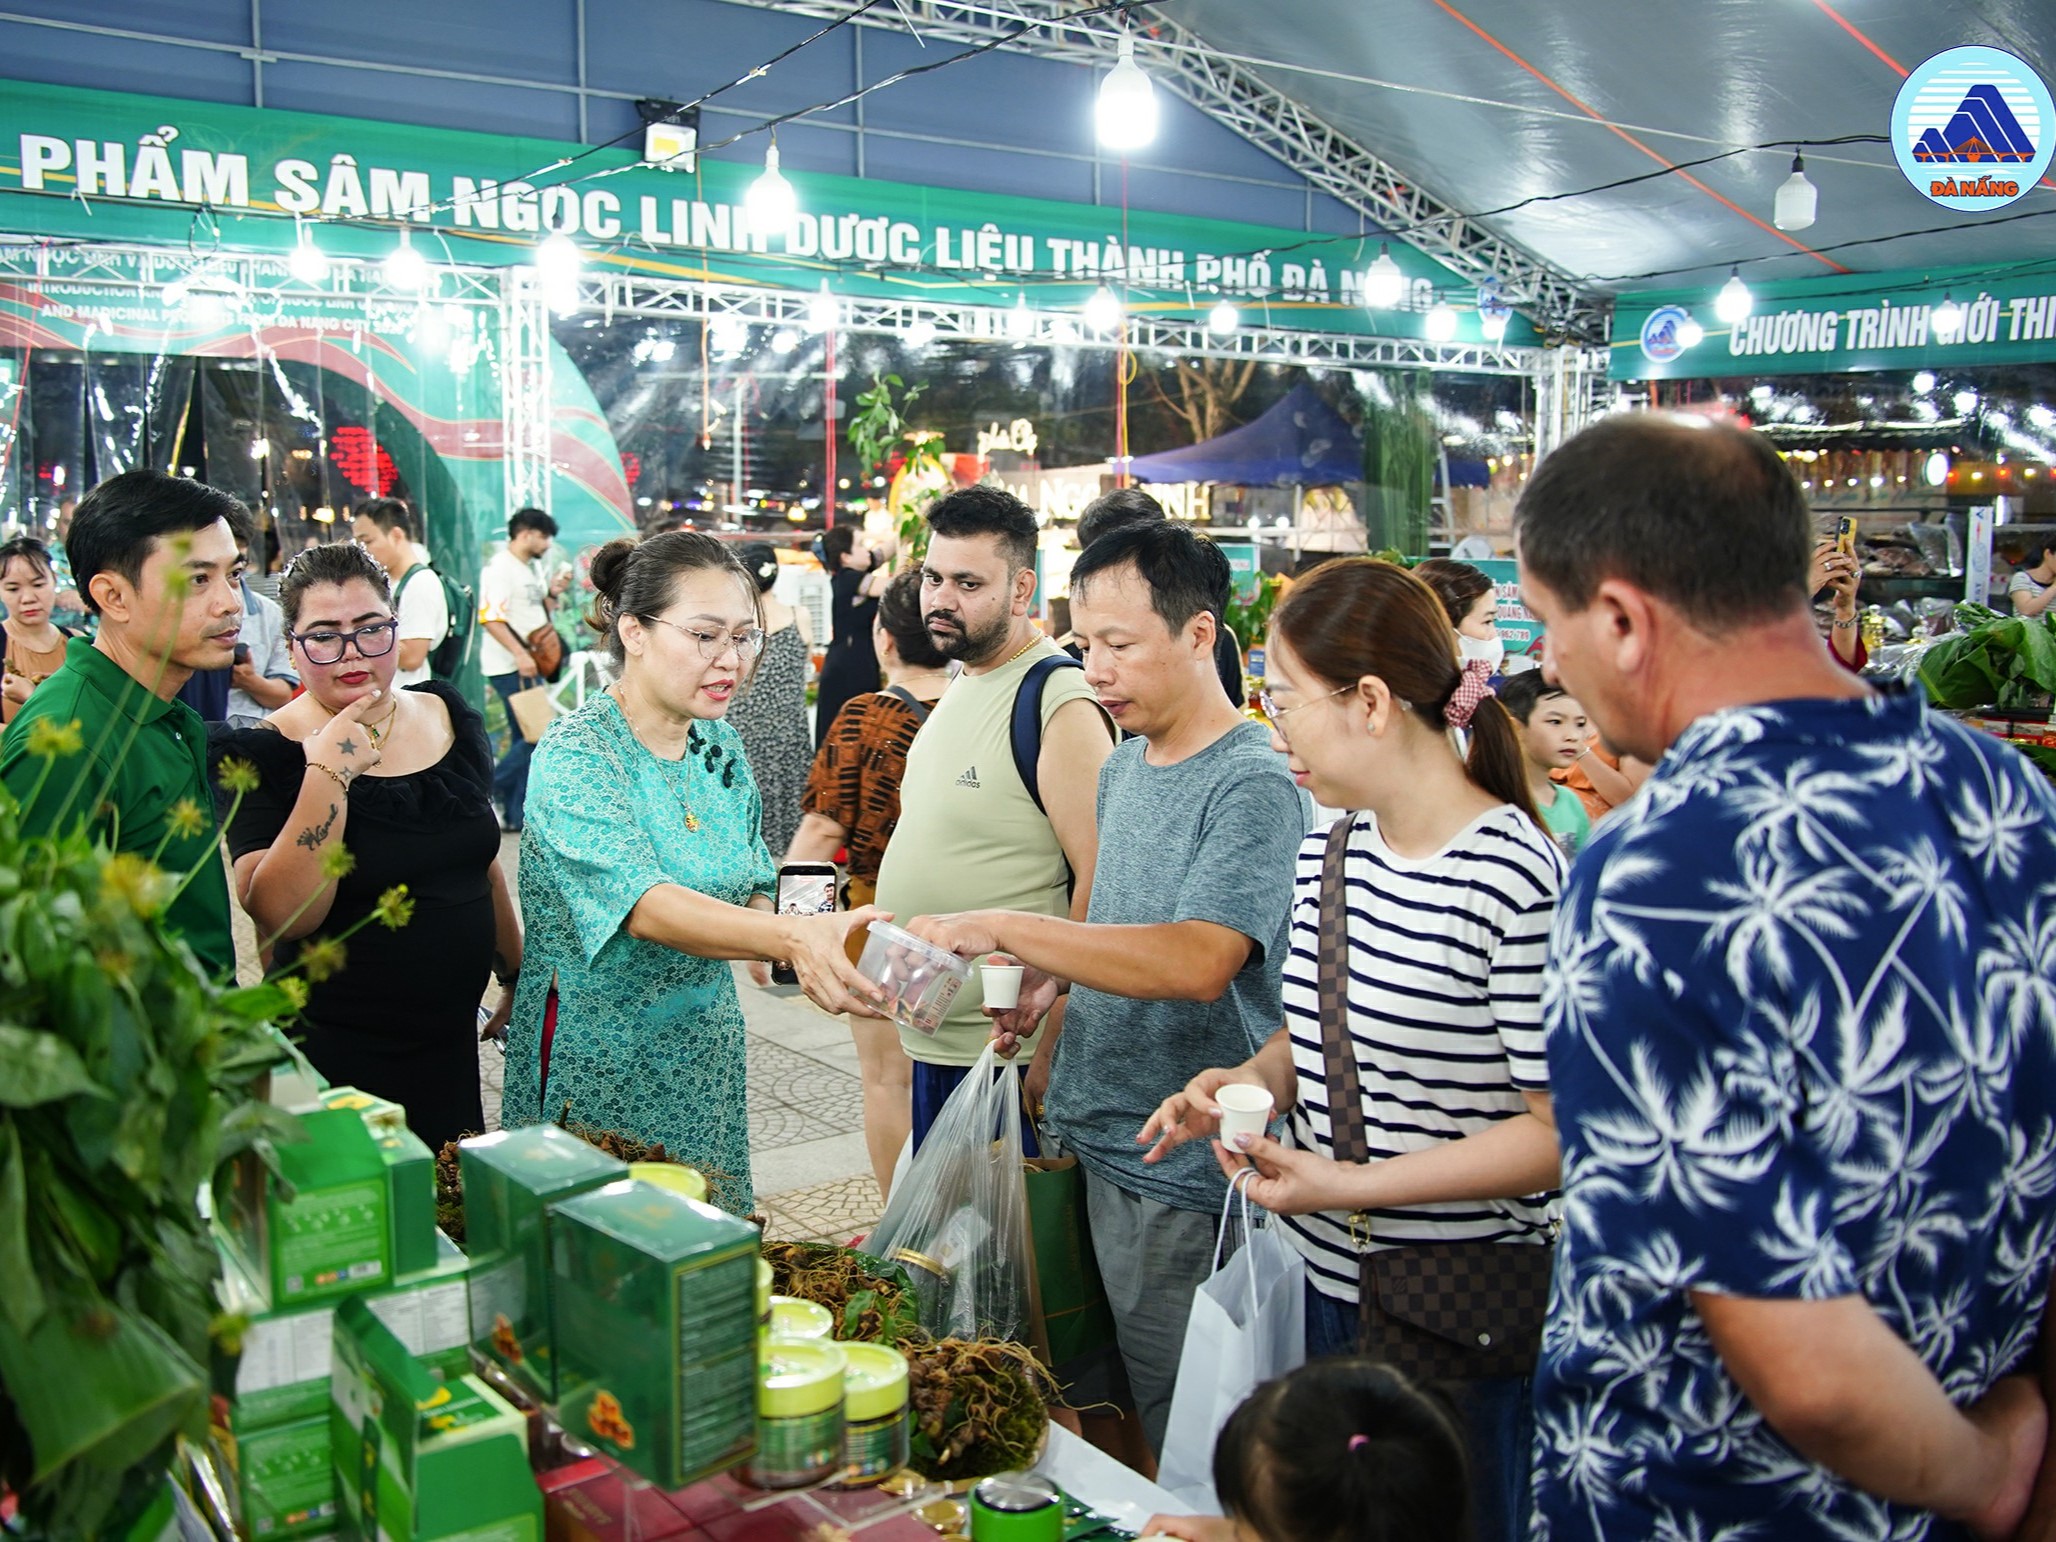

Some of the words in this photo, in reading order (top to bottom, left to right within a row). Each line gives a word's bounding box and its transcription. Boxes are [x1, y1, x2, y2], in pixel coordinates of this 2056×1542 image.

[20, 125, 249, 207] PHẨM
[273, 153, 432, 223] SÂM
[640, 195, 768, 253] LINH
[936, 223, 1035, 281] LIỆU
[1046, 235, 1184, 290] THÀNH
[1196, 249, 1272, 298] PHỐ
[1281, 259, 1330, 304] ĐÀ
[1341, 270, 1433, 314] NNG
[41, 303, 74, 318] AND
[1729, 309, 1839, 357] CHƯƠNG
[1846, 299, 1931, 350] TRÌNH
